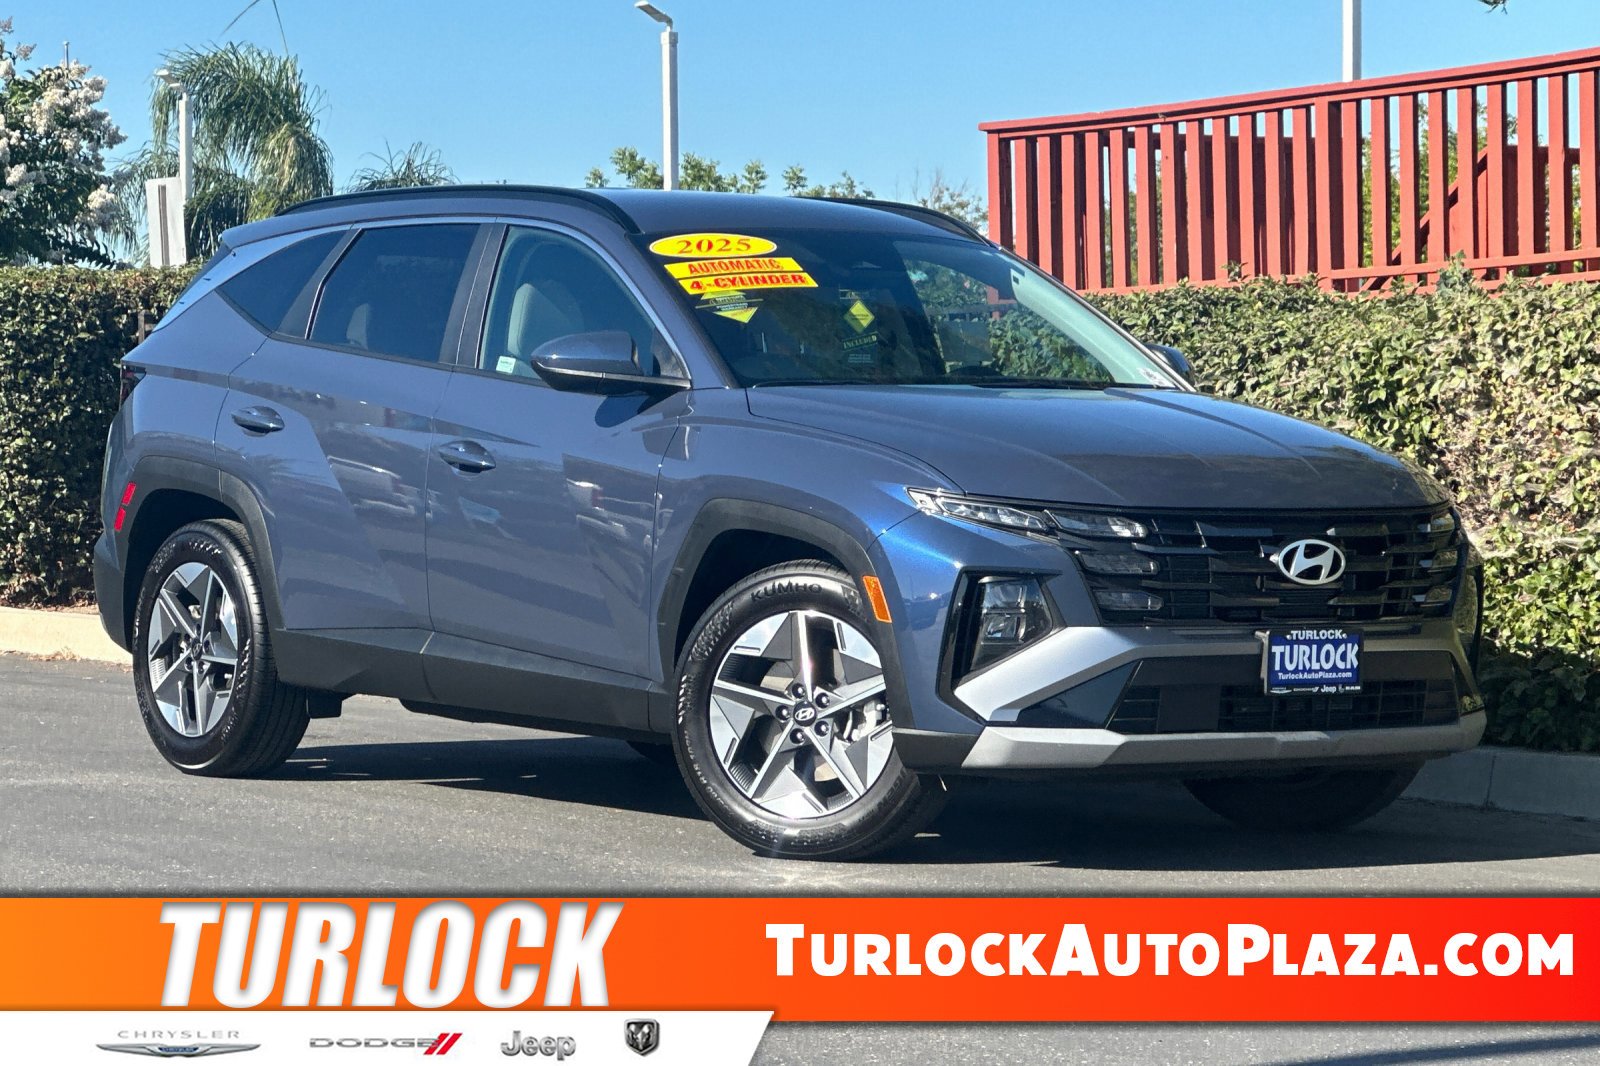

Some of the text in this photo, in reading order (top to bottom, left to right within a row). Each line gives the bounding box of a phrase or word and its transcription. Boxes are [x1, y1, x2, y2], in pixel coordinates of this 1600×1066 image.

[678, 239, 752, 254] 2025
[688, 259, 780, 275] AUTOMATIC
[751, 580, 822, 602] KUMHO
[1291, 630, 1343, 640] TURLOCK
[1271, 644, 1359, 671] TURLOCK
[1278, 671, 1352, 680] TurlockAutoPlaza.com
[1321, 685, 1337, 693] Jeep
